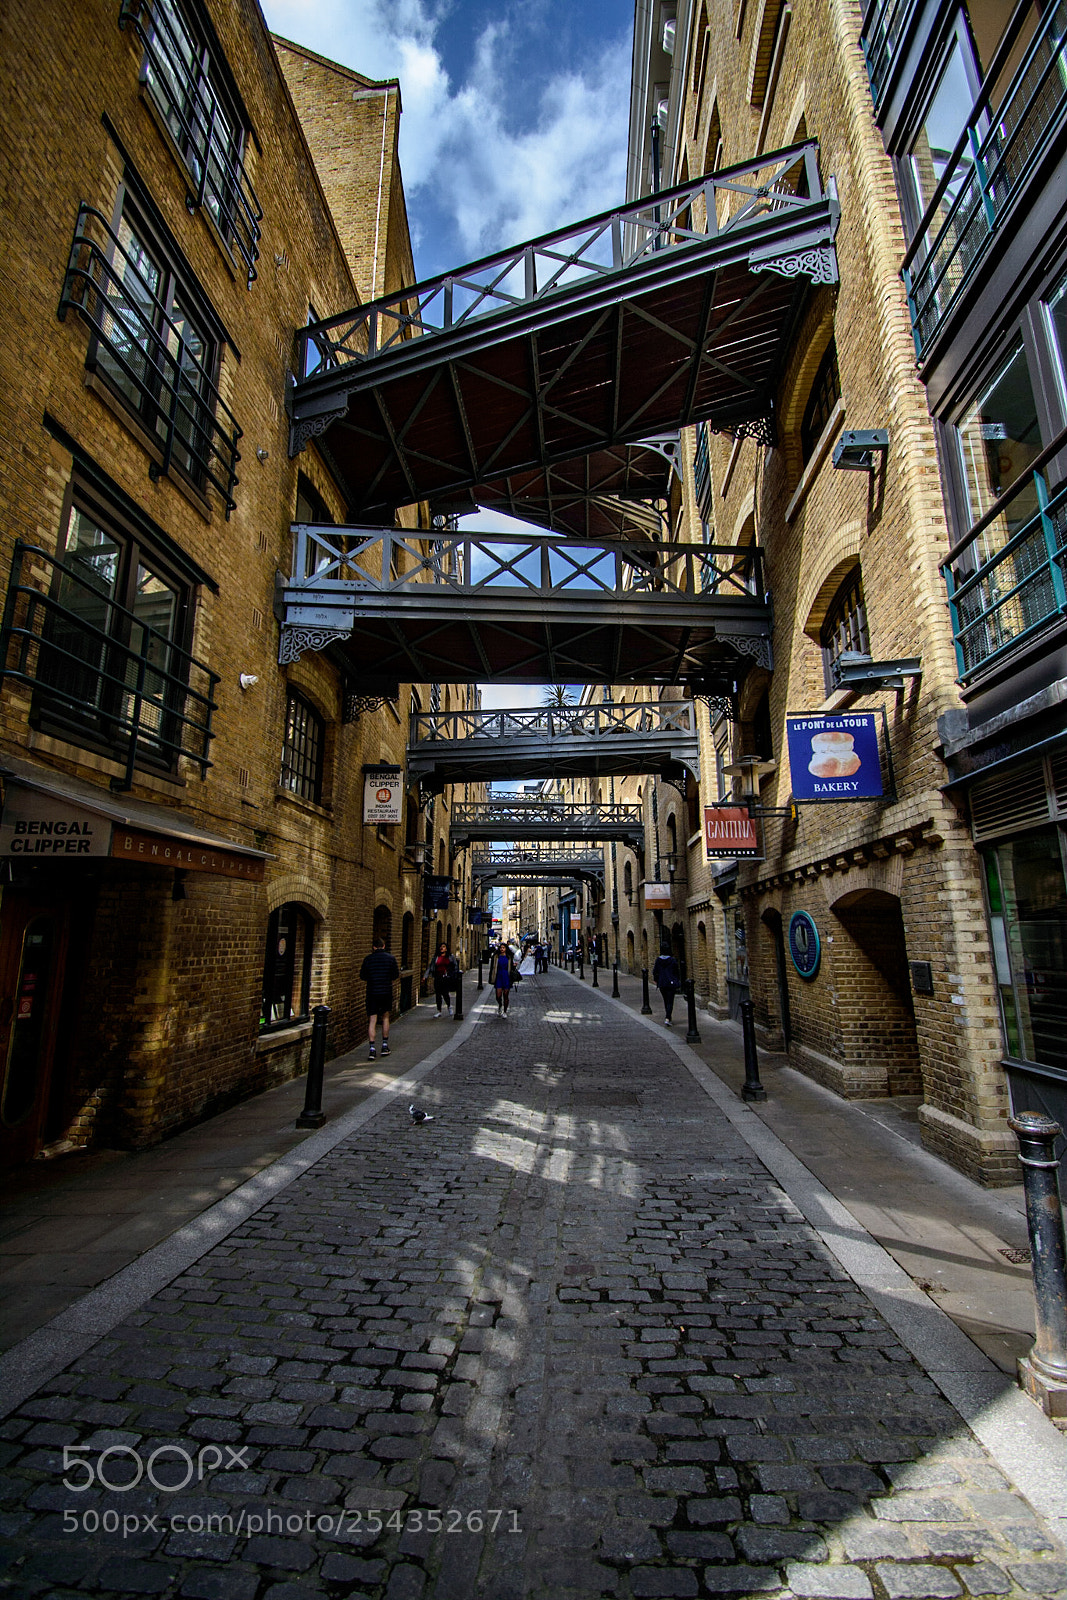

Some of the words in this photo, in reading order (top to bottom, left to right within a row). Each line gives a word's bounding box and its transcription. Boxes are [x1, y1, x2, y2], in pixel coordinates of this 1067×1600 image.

[793, 723, 801, 731] LE
[801, 720, 825, 730] PONT
[826, 721, 835, 729] DE
[843, 718, 869, 727] TOUR
[813, 781, 859, 792] BAKERY
[14, 820, 93, 835] BENGAL
[707, 820, 754, 839] CANTINA
[10, 838, 91, 853] CLIPPER
[124, 836, 193, 862] BENGAL
[201, 855, 260, 875] CLIPPER
